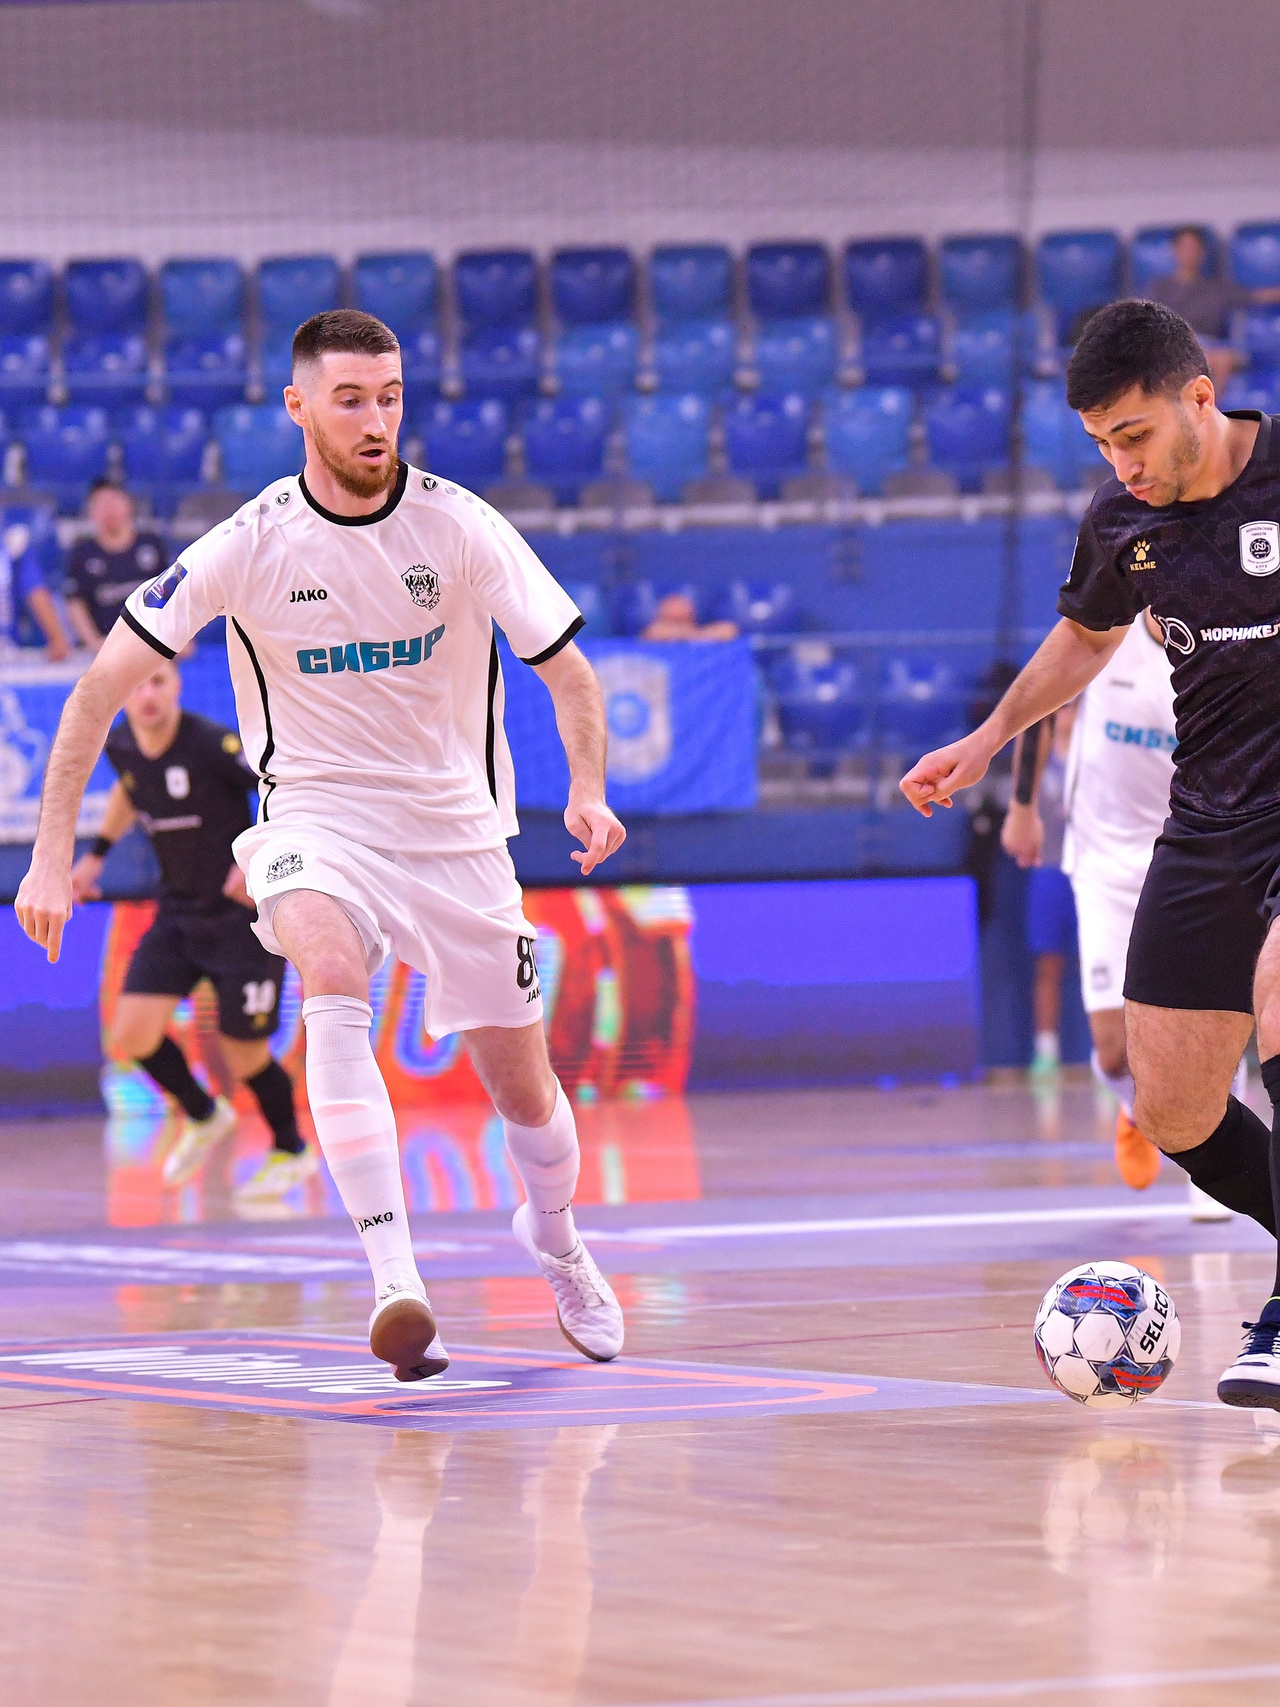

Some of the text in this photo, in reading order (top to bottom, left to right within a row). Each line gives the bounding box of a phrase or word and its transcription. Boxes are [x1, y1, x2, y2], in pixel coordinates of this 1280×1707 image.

[1130, 561, 1156, 571] KELME
[289, 589, 328, 602] JAKO
[296, 623, 446, 674] СИБУР
[1105, 720, 1181, 753] СИБУ
[358, 1211, 394, 1233] JAKO
[1139, 1284, 1169, 1355] SELECT
